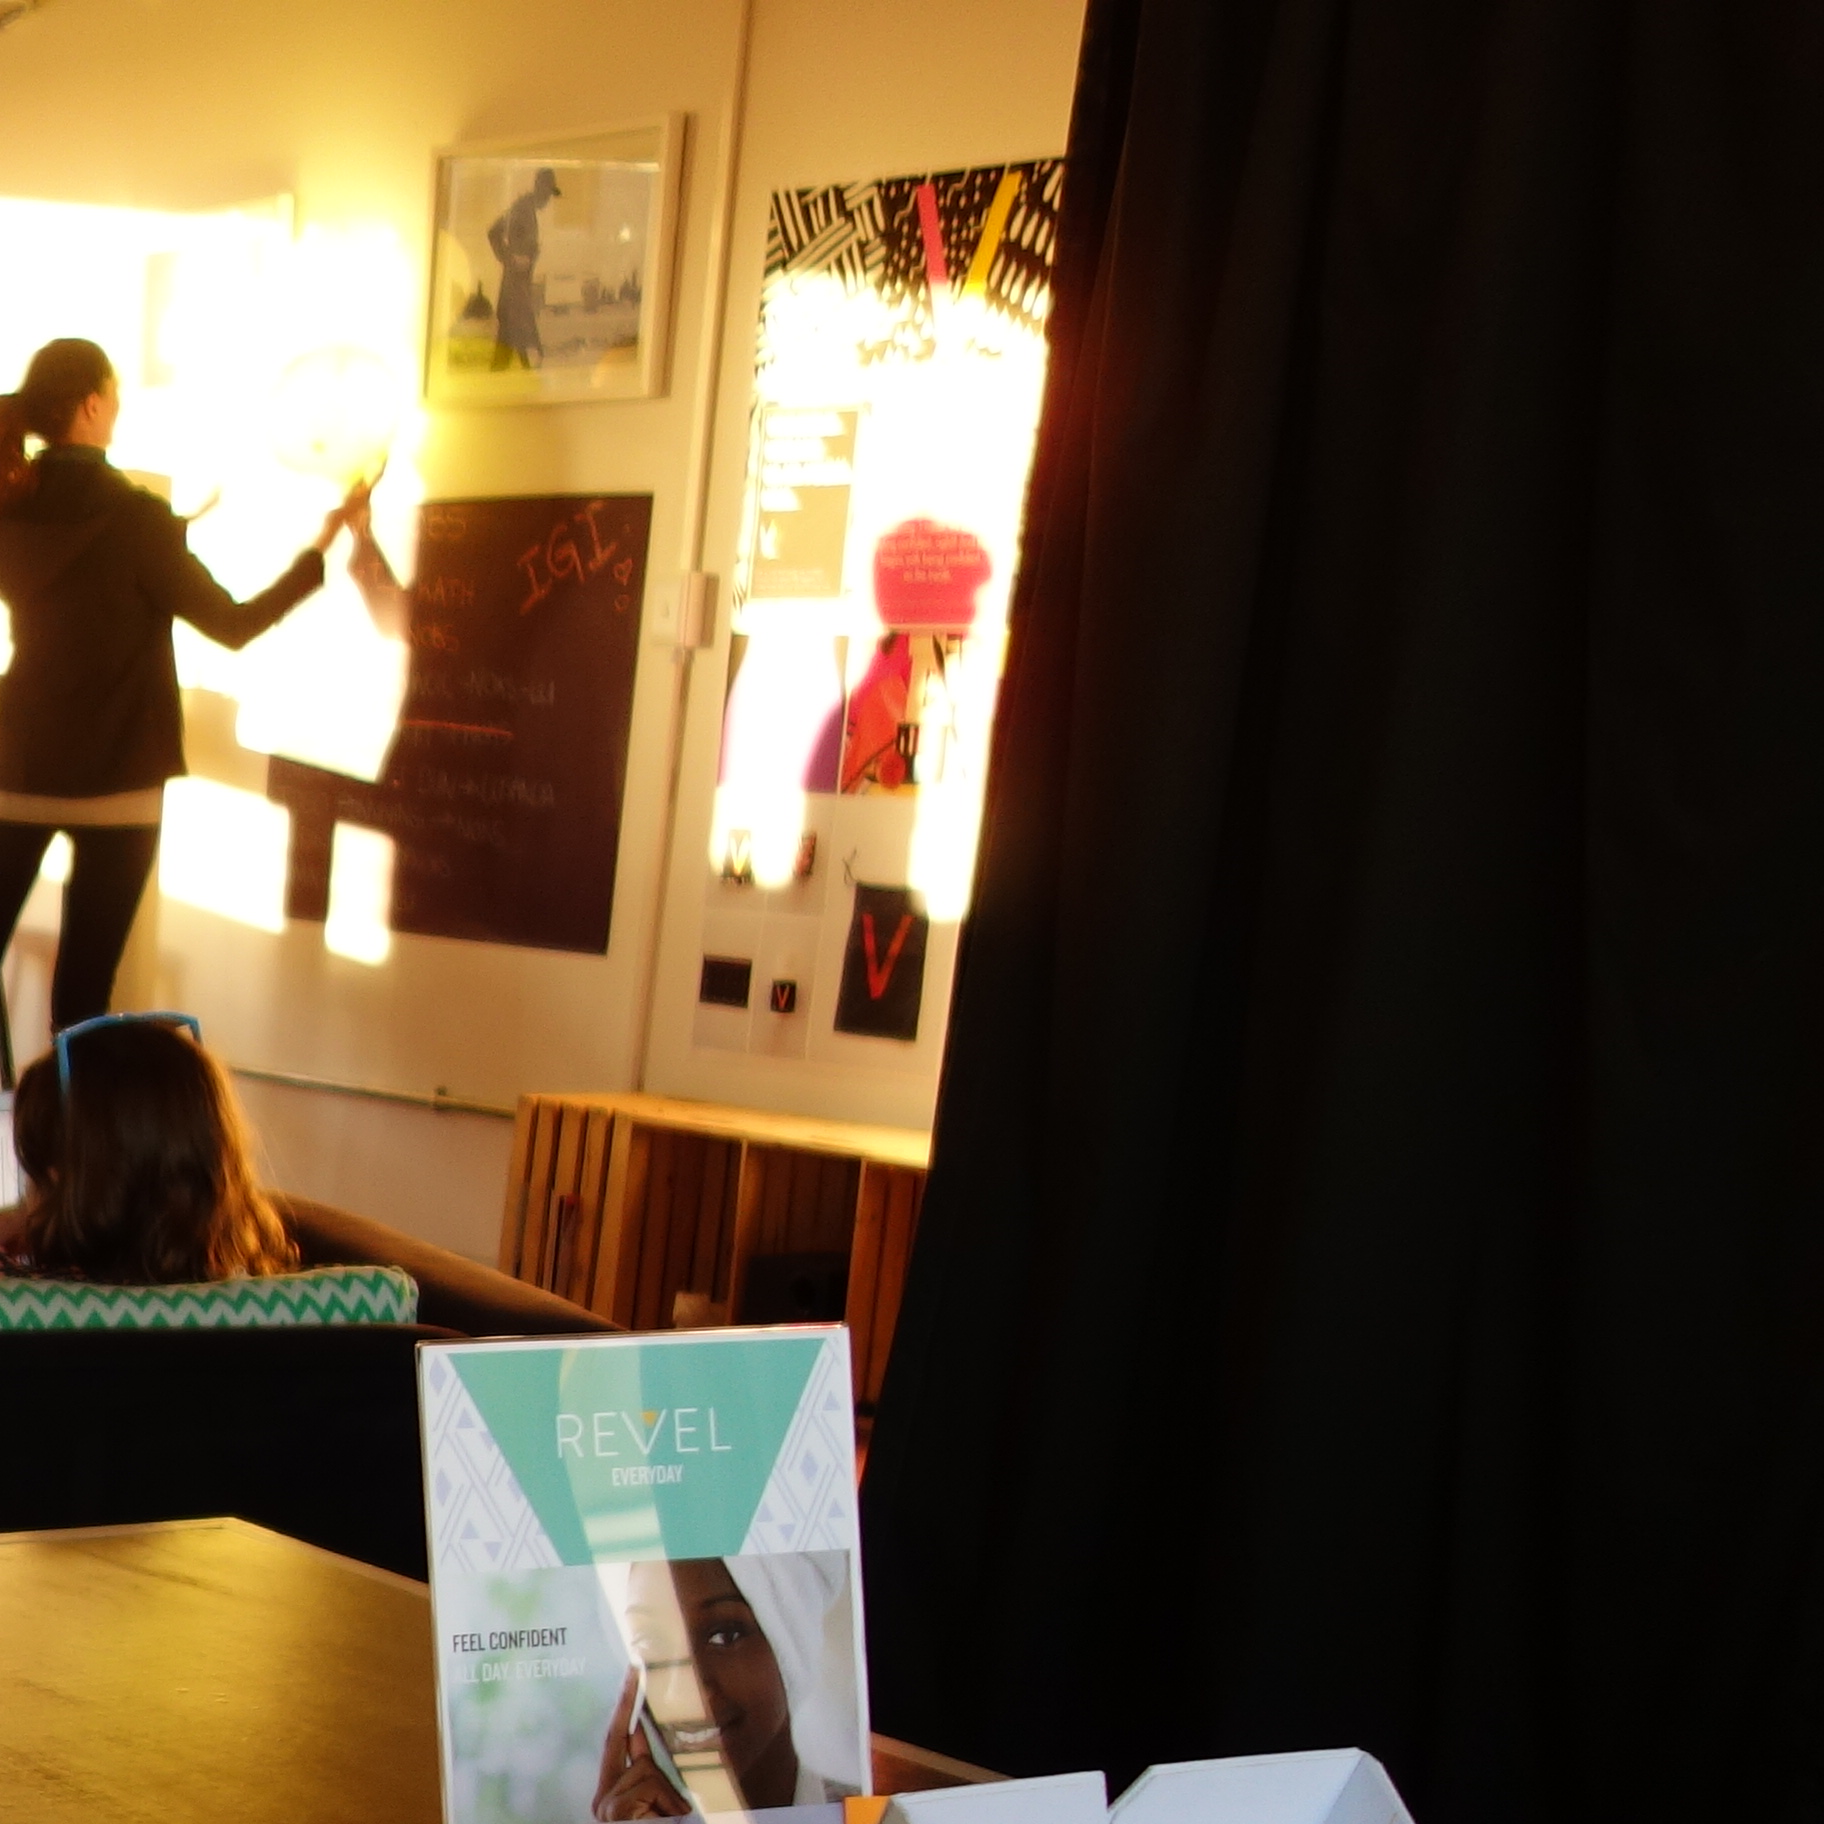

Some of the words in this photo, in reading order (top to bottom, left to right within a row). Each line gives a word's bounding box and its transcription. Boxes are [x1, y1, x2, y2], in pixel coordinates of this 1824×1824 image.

[862, 913, 914, 1000] V
[556, 1406, 732, 1458] REVEL
[611, 1463, 684, 1487] EVERYDAY
[452, 1632, 486, 1652] FEEL
[488, 1626, 567, 1651] CONFIDENT
[482, 1661, 509, 1682] DAY
[514, 1656, 587, 1680] EVERYDAY
